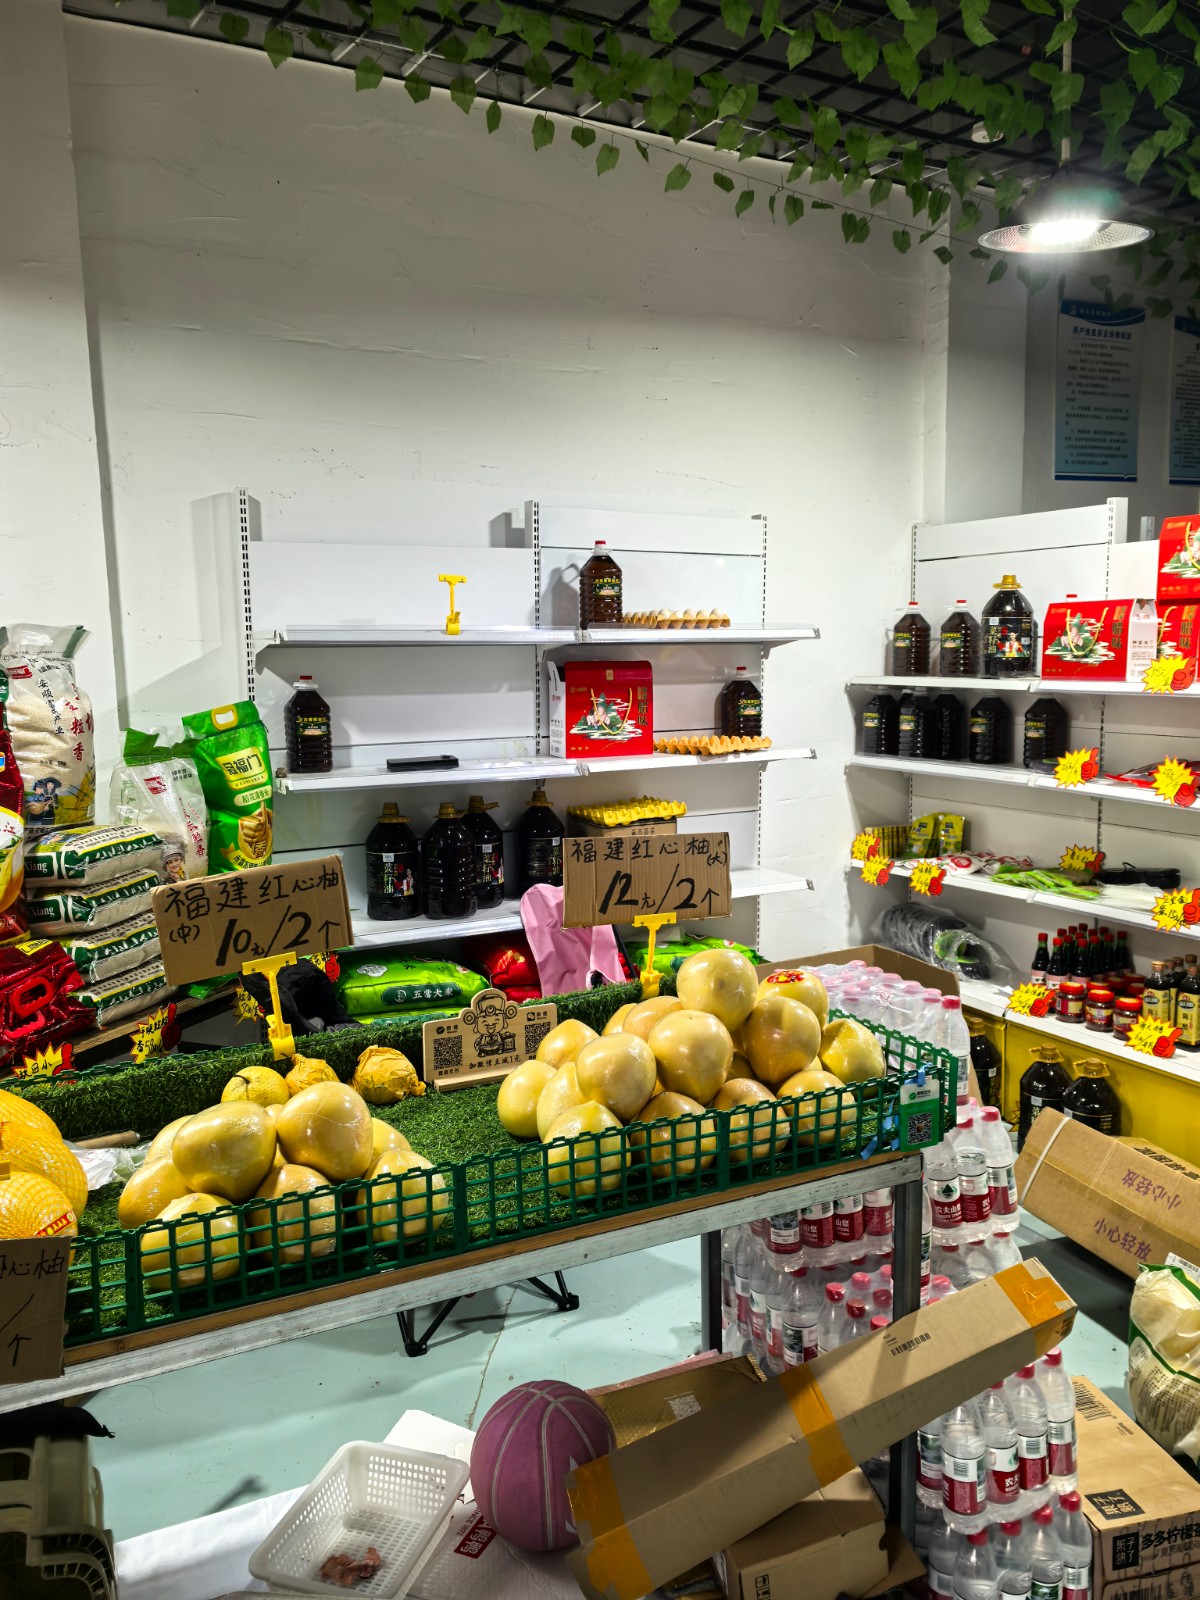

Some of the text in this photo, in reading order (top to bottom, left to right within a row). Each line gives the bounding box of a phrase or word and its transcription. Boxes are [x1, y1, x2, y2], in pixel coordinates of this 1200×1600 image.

[571, 837, 710, 863] 福建红心柚
[164, 864, 339, 920] 福建红心柚
[1094, 1217, 1153, 1262] 小心轻放
[0, 1249, 65, 1280] 心柚
